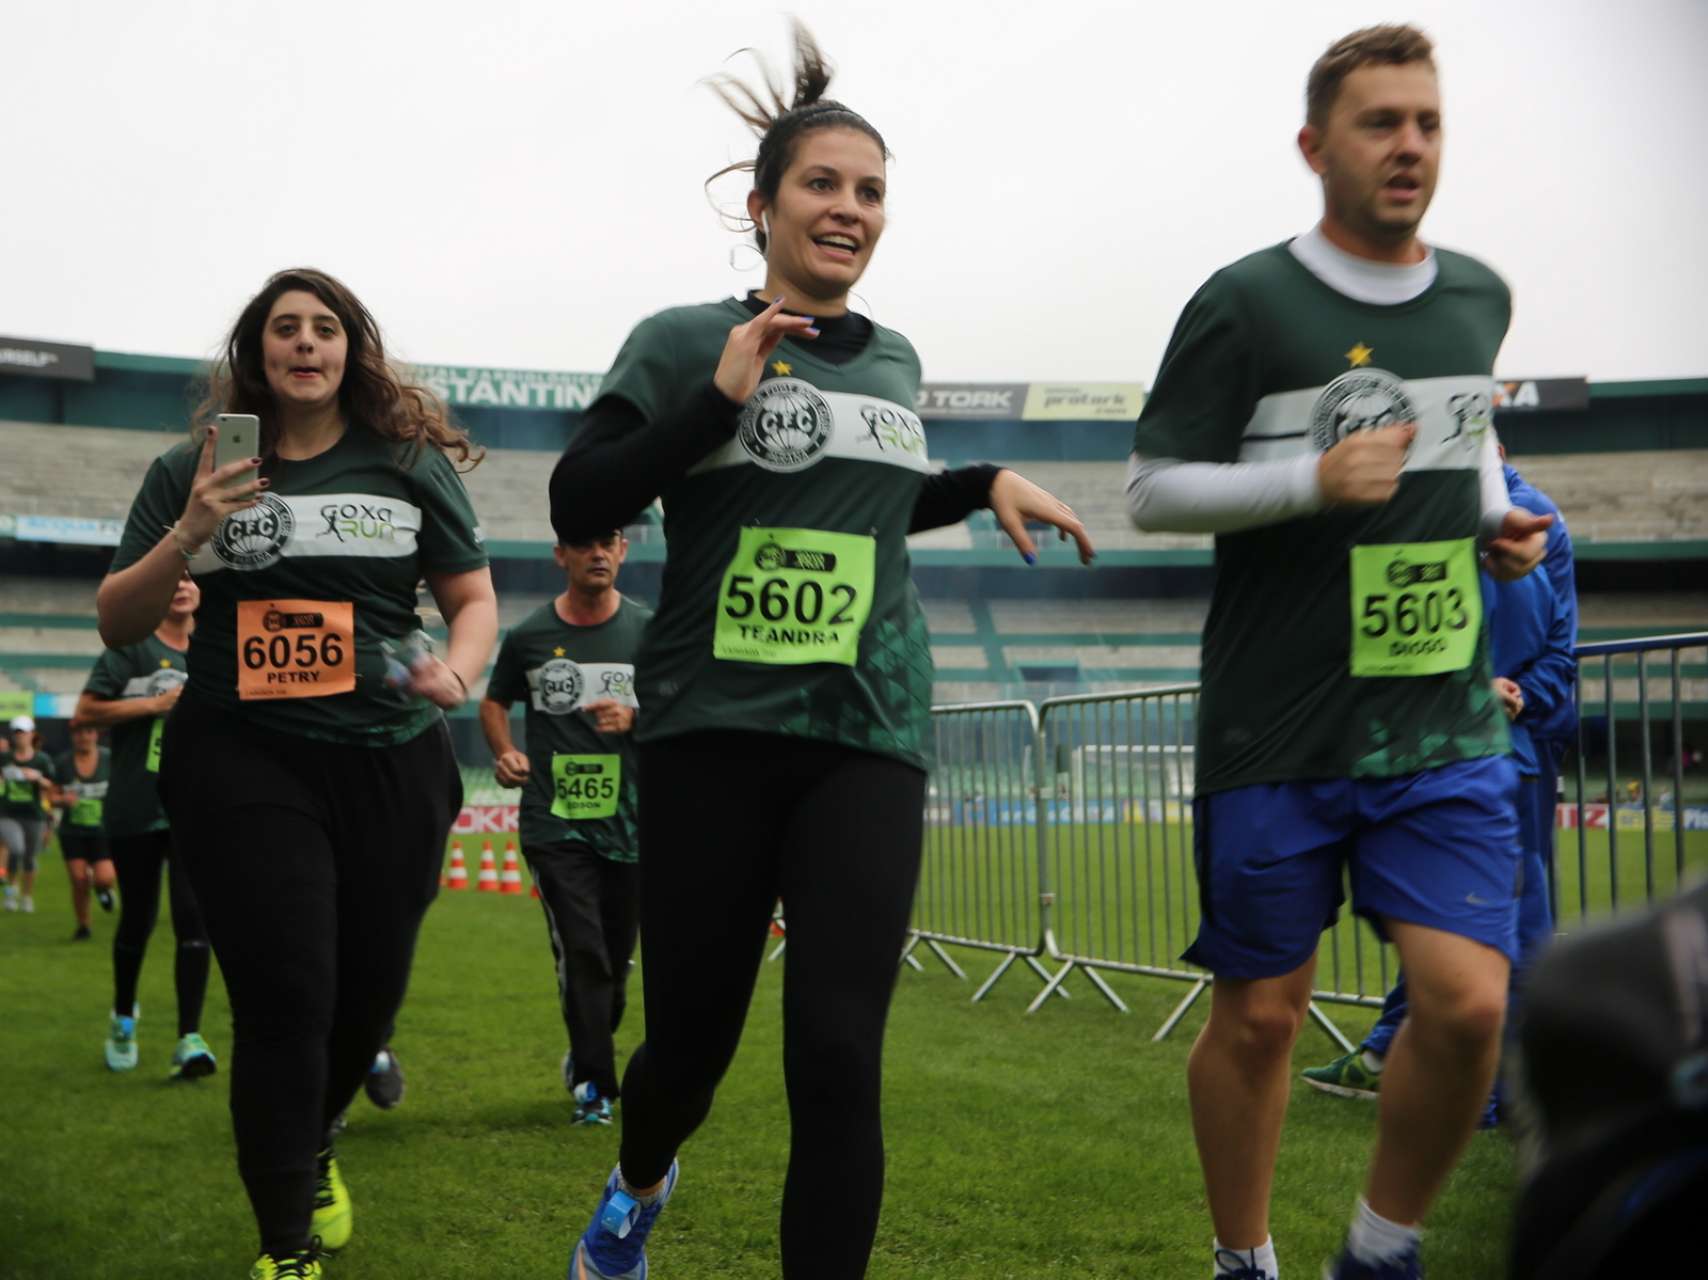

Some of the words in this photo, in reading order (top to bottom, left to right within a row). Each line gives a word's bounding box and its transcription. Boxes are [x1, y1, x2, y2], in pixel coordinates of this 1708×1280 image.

[932, 390, 1013, 408] TORK
[228, 516, 274, 541] CFC
[724, 574, 857, 626] 5602
[1361, 588, 1469, 638] 5603
[243, 632, 344, 670] 6056
[267, 671, 320, 684] PETRY
[556, 777, 614, 800] 5465
